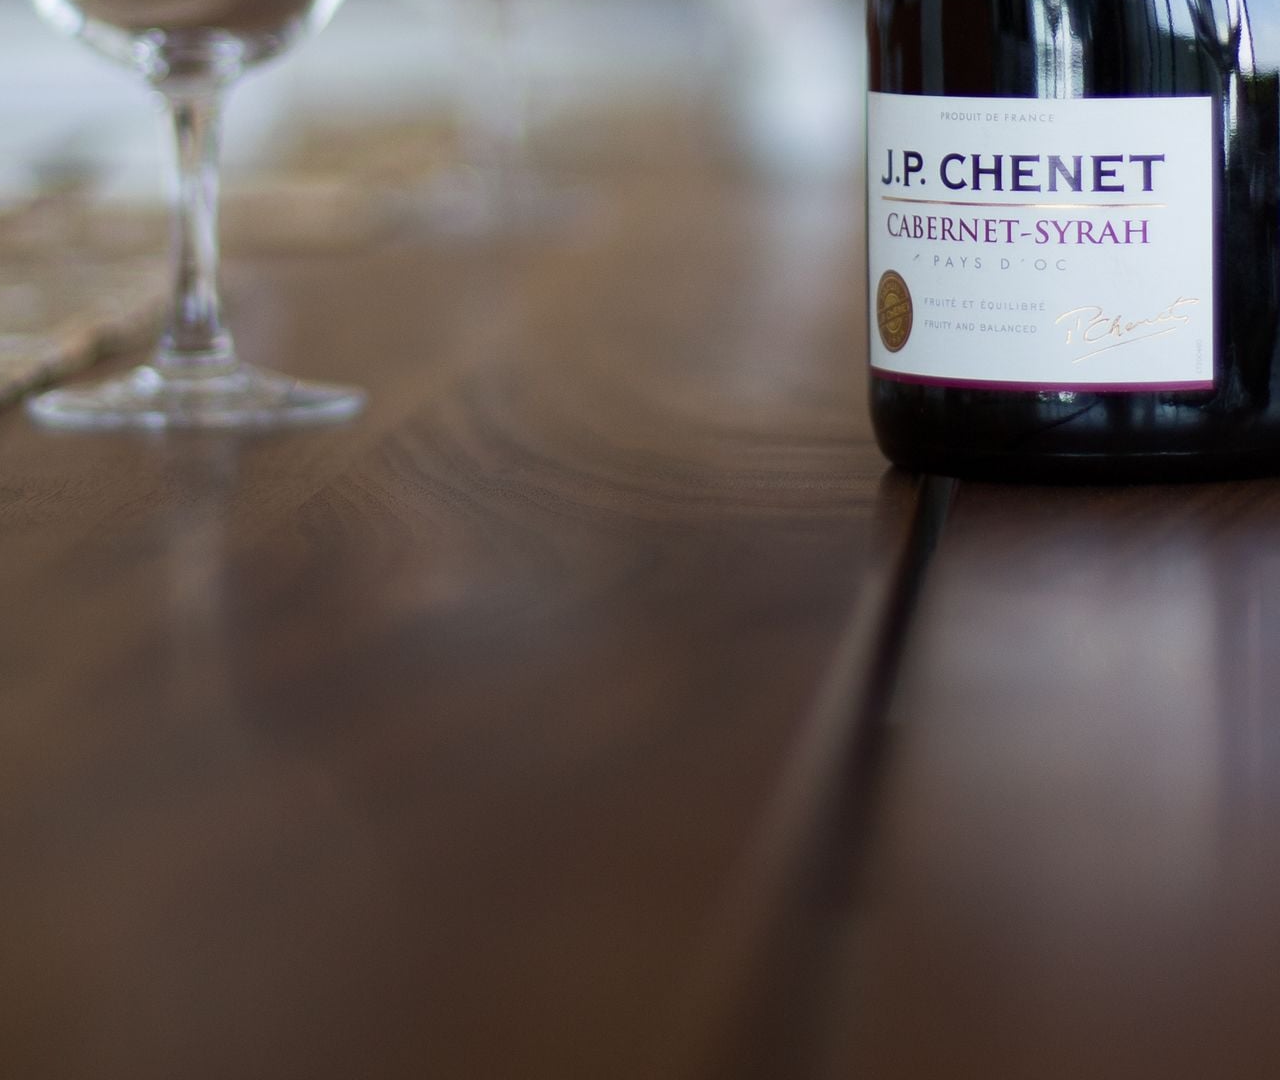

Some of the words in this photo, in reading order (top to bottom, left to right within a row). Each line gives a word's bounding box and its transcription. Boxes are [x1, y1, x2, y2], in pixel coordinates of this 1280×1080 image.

[940, 111, 981, 121] PRODUIT
[985, 113, 999, 122] DE
[1004, 113, 1055, 123] FRANCE
[881, 149, 926, 187] J.P.
[940, 153, 1166, 192] CHENET
[887, 212, 1152, 245] CABERNET-SYRAH
[933, 255, 982, 270] PAYS
[1000, 257, 1068, 271] D'OC
[924, 297, 957, 307] FRUITÉ
[962, 300, 974, 308] ET
[980, 300, 1046, 311] ÉQUILIBRÉ
[924, 320, 951, 329] FRUITY
[955, 322, 975, 331] AND
[980, 324, 1037, 333] BALANCED
